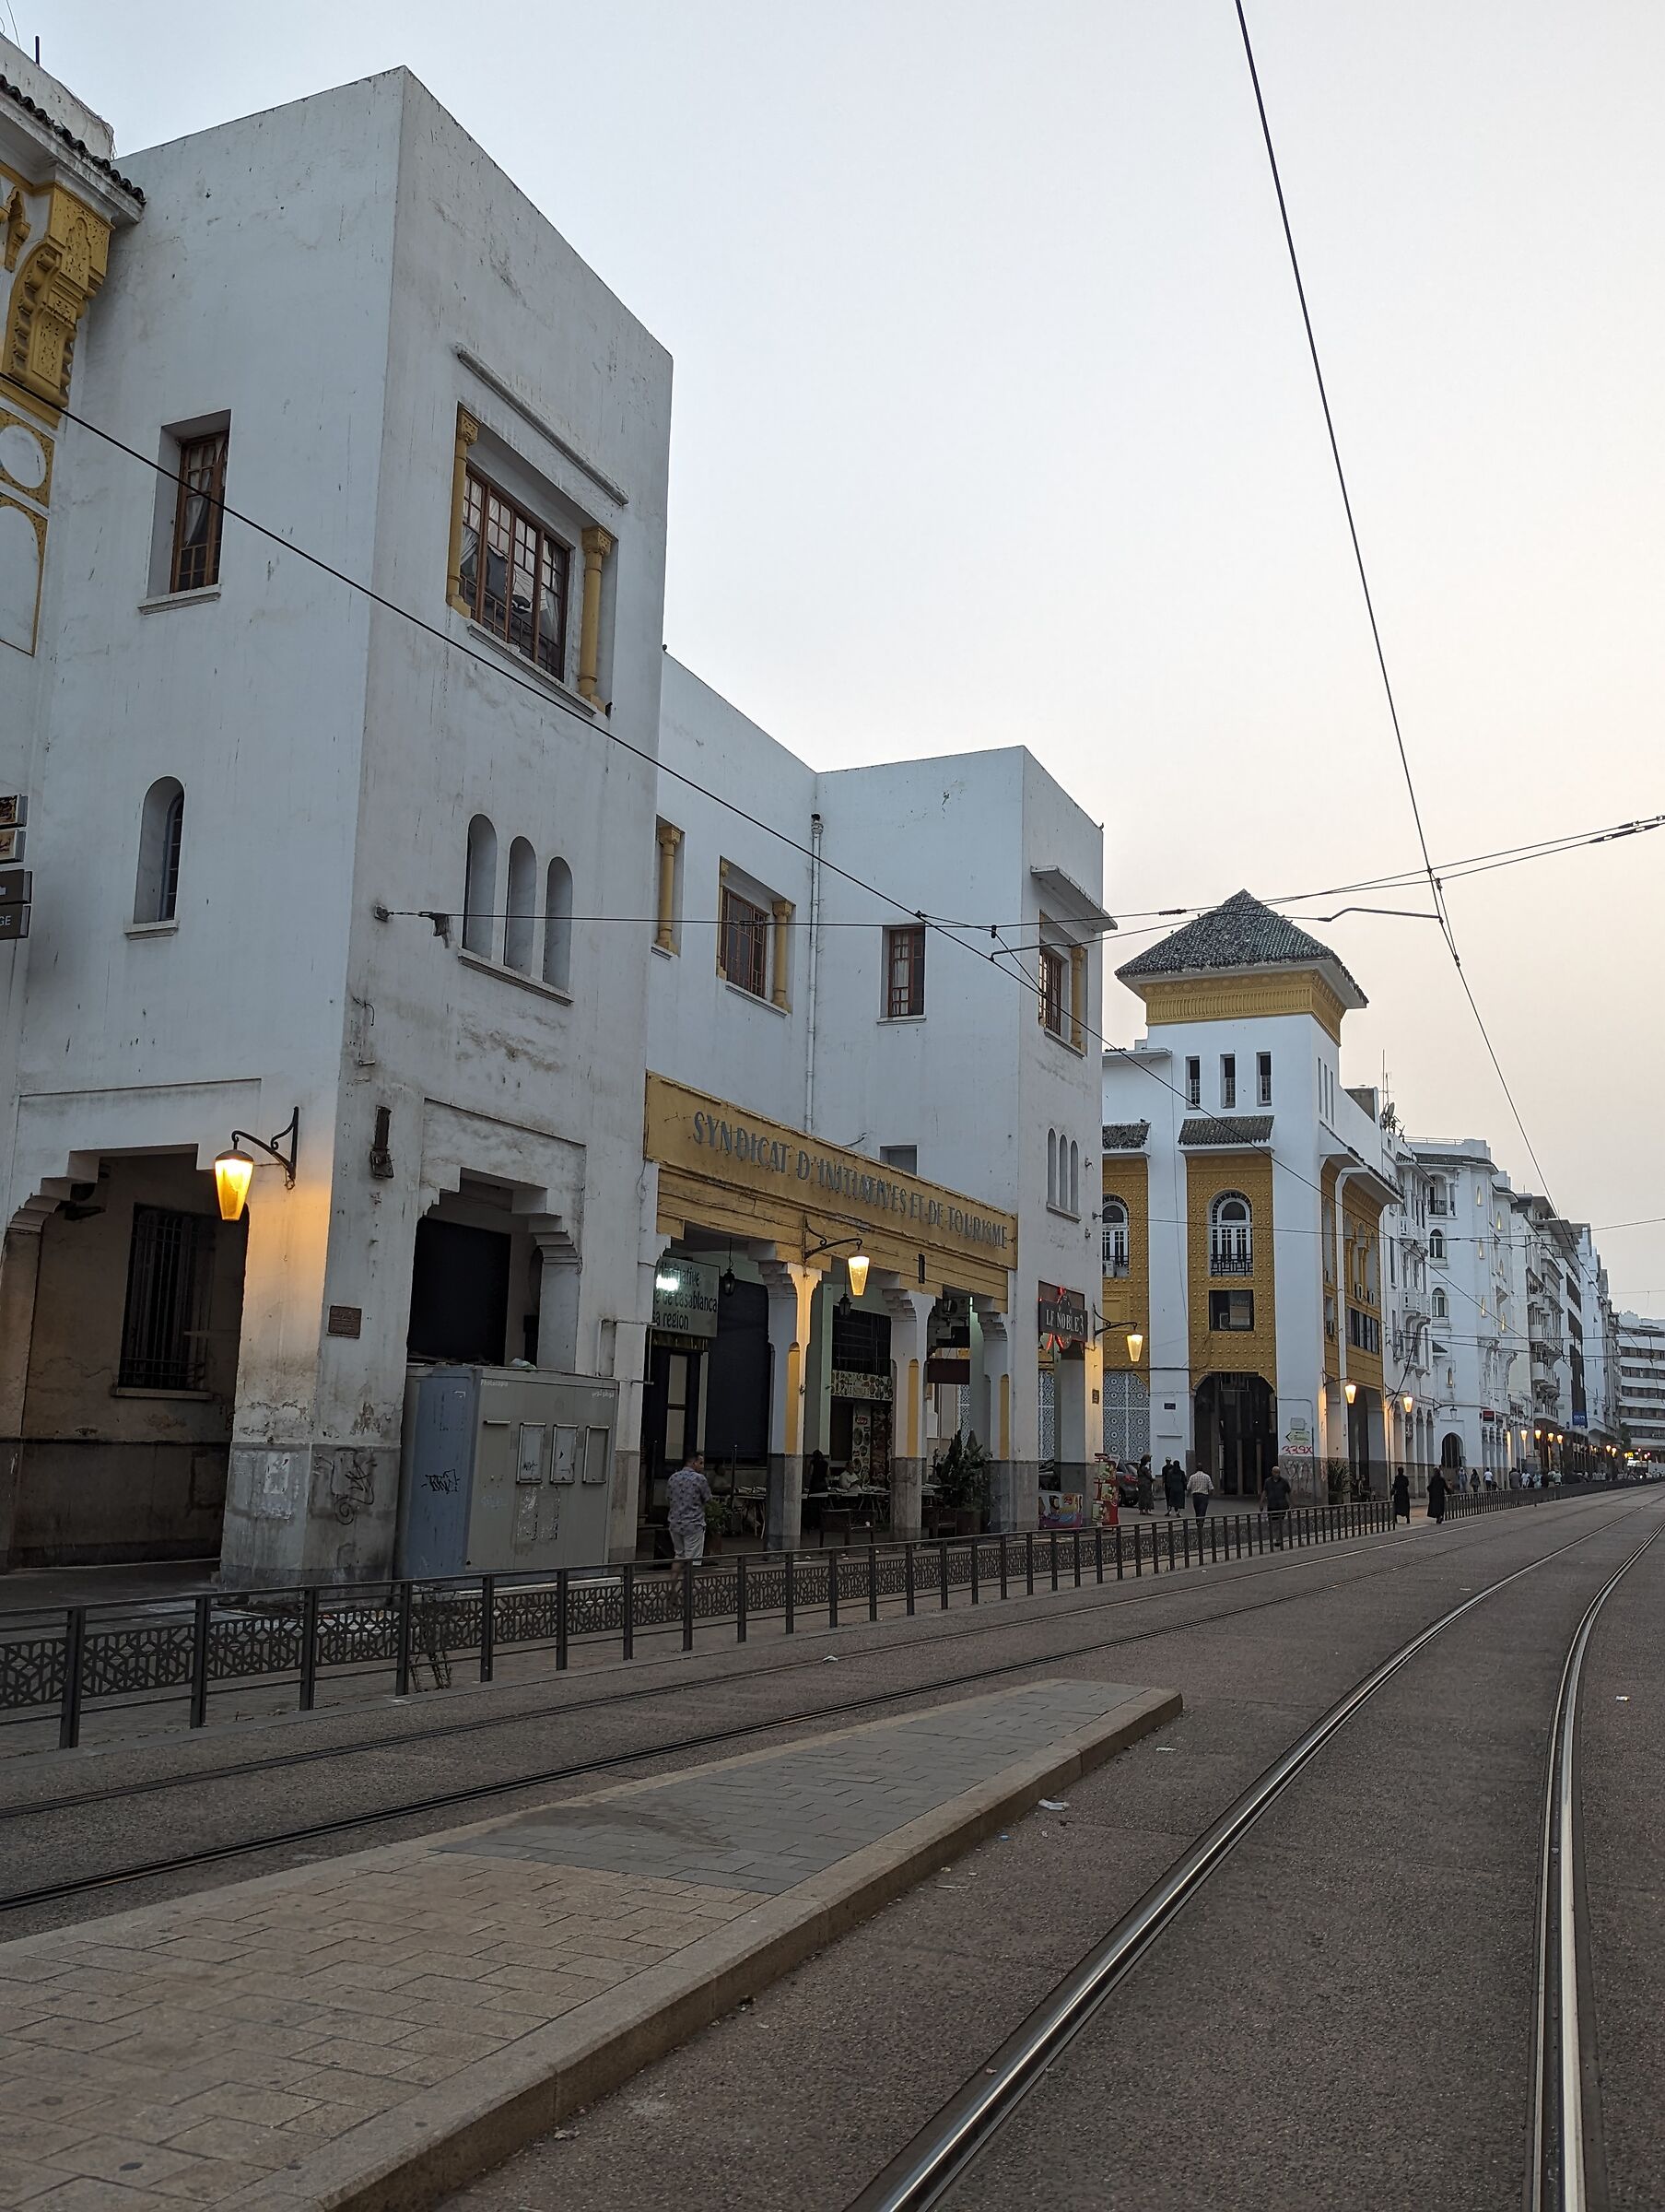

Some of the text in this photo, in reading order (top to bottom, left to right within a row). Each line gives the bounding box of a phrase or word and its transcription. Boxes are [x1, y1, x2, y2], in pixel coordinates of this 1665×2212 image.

[693, 1111, 1007, 1250] SYNDICAT D'INITIATIVES ET DE TOURISME
[674, 1290, 718, 1312] casablanca
[1046, 1309, 1055, 1326] LE
